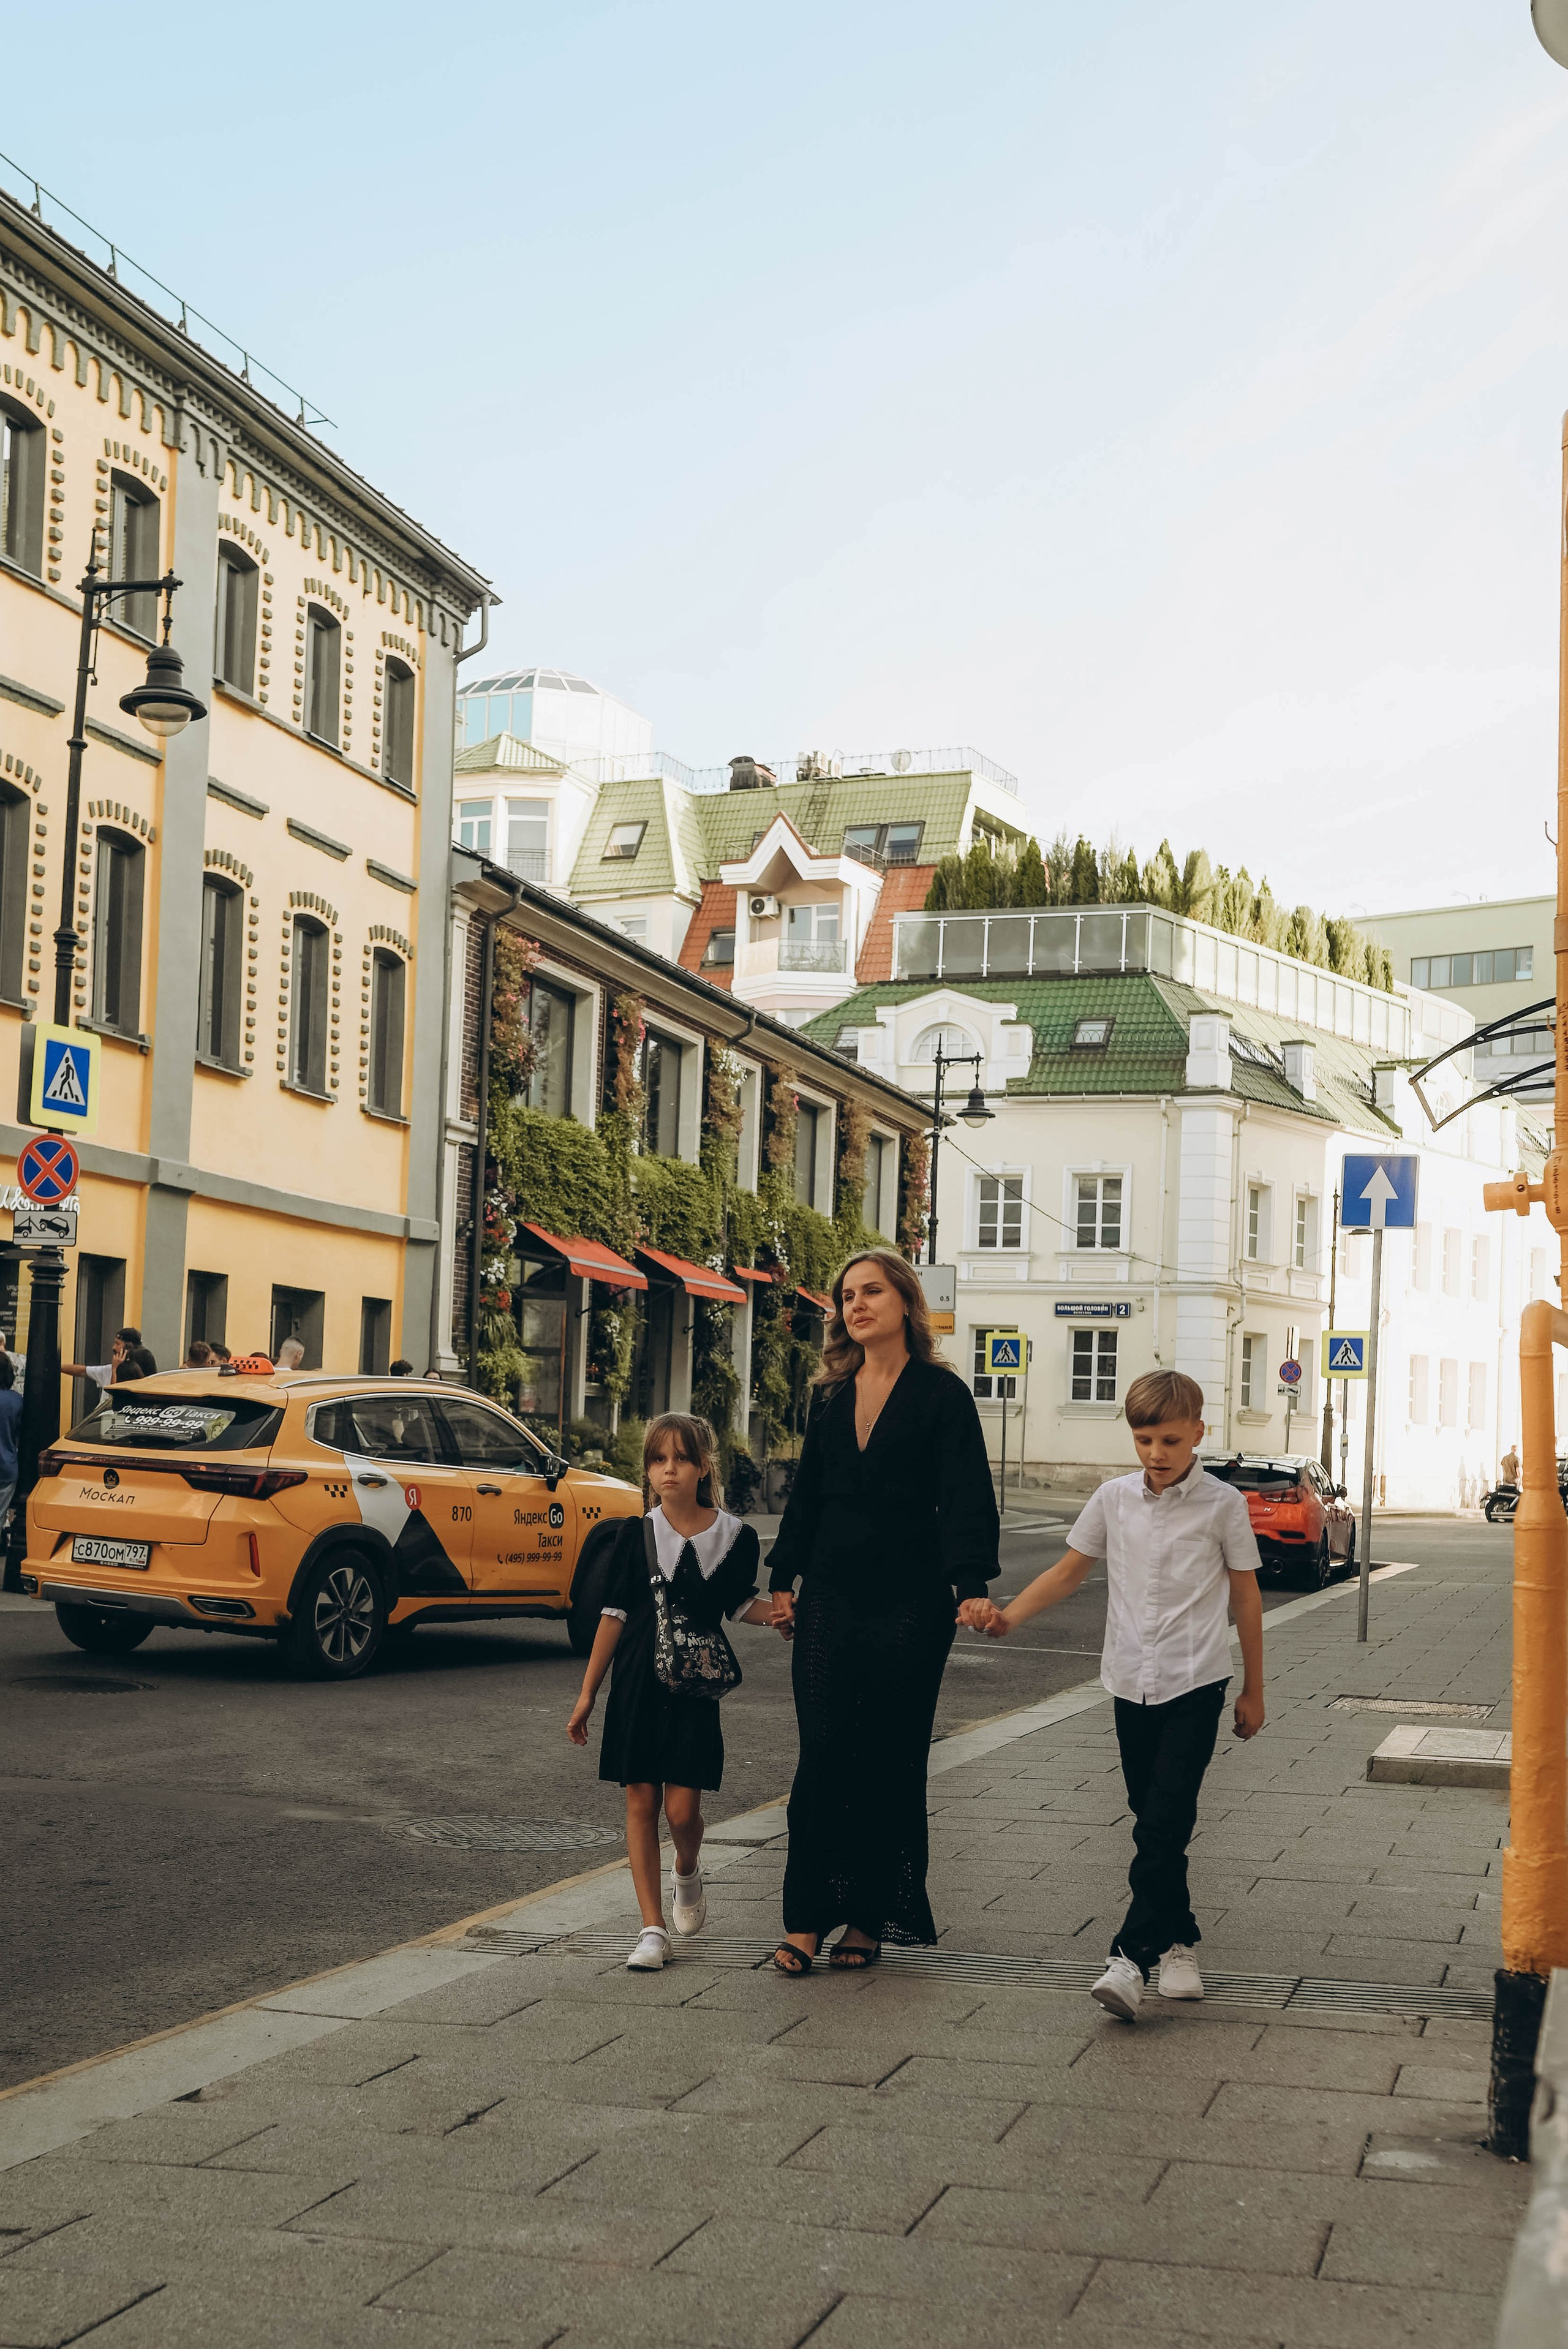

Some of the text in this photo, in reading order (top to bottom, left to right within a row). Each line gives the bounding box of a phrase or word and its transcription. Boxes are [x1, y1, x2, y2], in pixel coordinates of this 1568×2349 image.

[1119, 1305, 1126, 1314] 2
[118, 1405, 162, 1415] Яндекс
[184, 1409, 222, 1419] Такси
[132, 1416, 205, 1429] 999-99-99
[408, 1488, 417, 1506] Я
[451, 1506, 472, 1522] 870
[514, 1508, 564, 1526] Яндекс Go
[538, 1533, 563, 1548] Такси
[126, 1545, 146, 1558] 797
[505, 1552, 562, 1565] (495) 999-99-99
